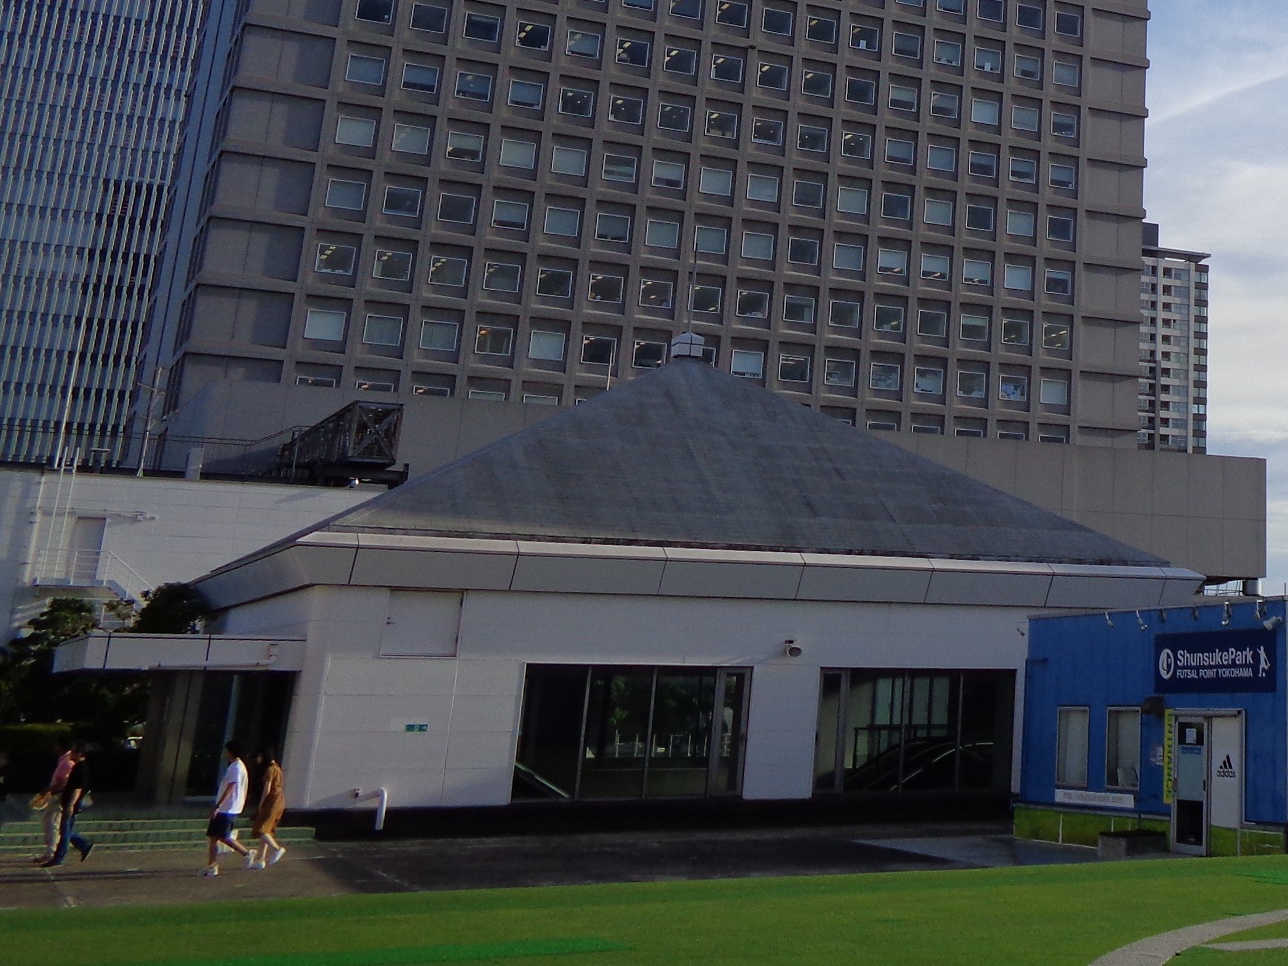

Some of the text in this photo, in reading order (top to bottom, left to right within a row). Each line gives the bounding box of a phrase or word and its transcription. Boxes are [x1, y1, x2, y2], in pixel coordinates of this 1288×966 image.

[1177, 646, 1254, 666] ShunsukePark
[1176, 667, 1253, 679] FUTSAL POINT YOKOHAMA
[1216, 769, 1236, 779] adidas
